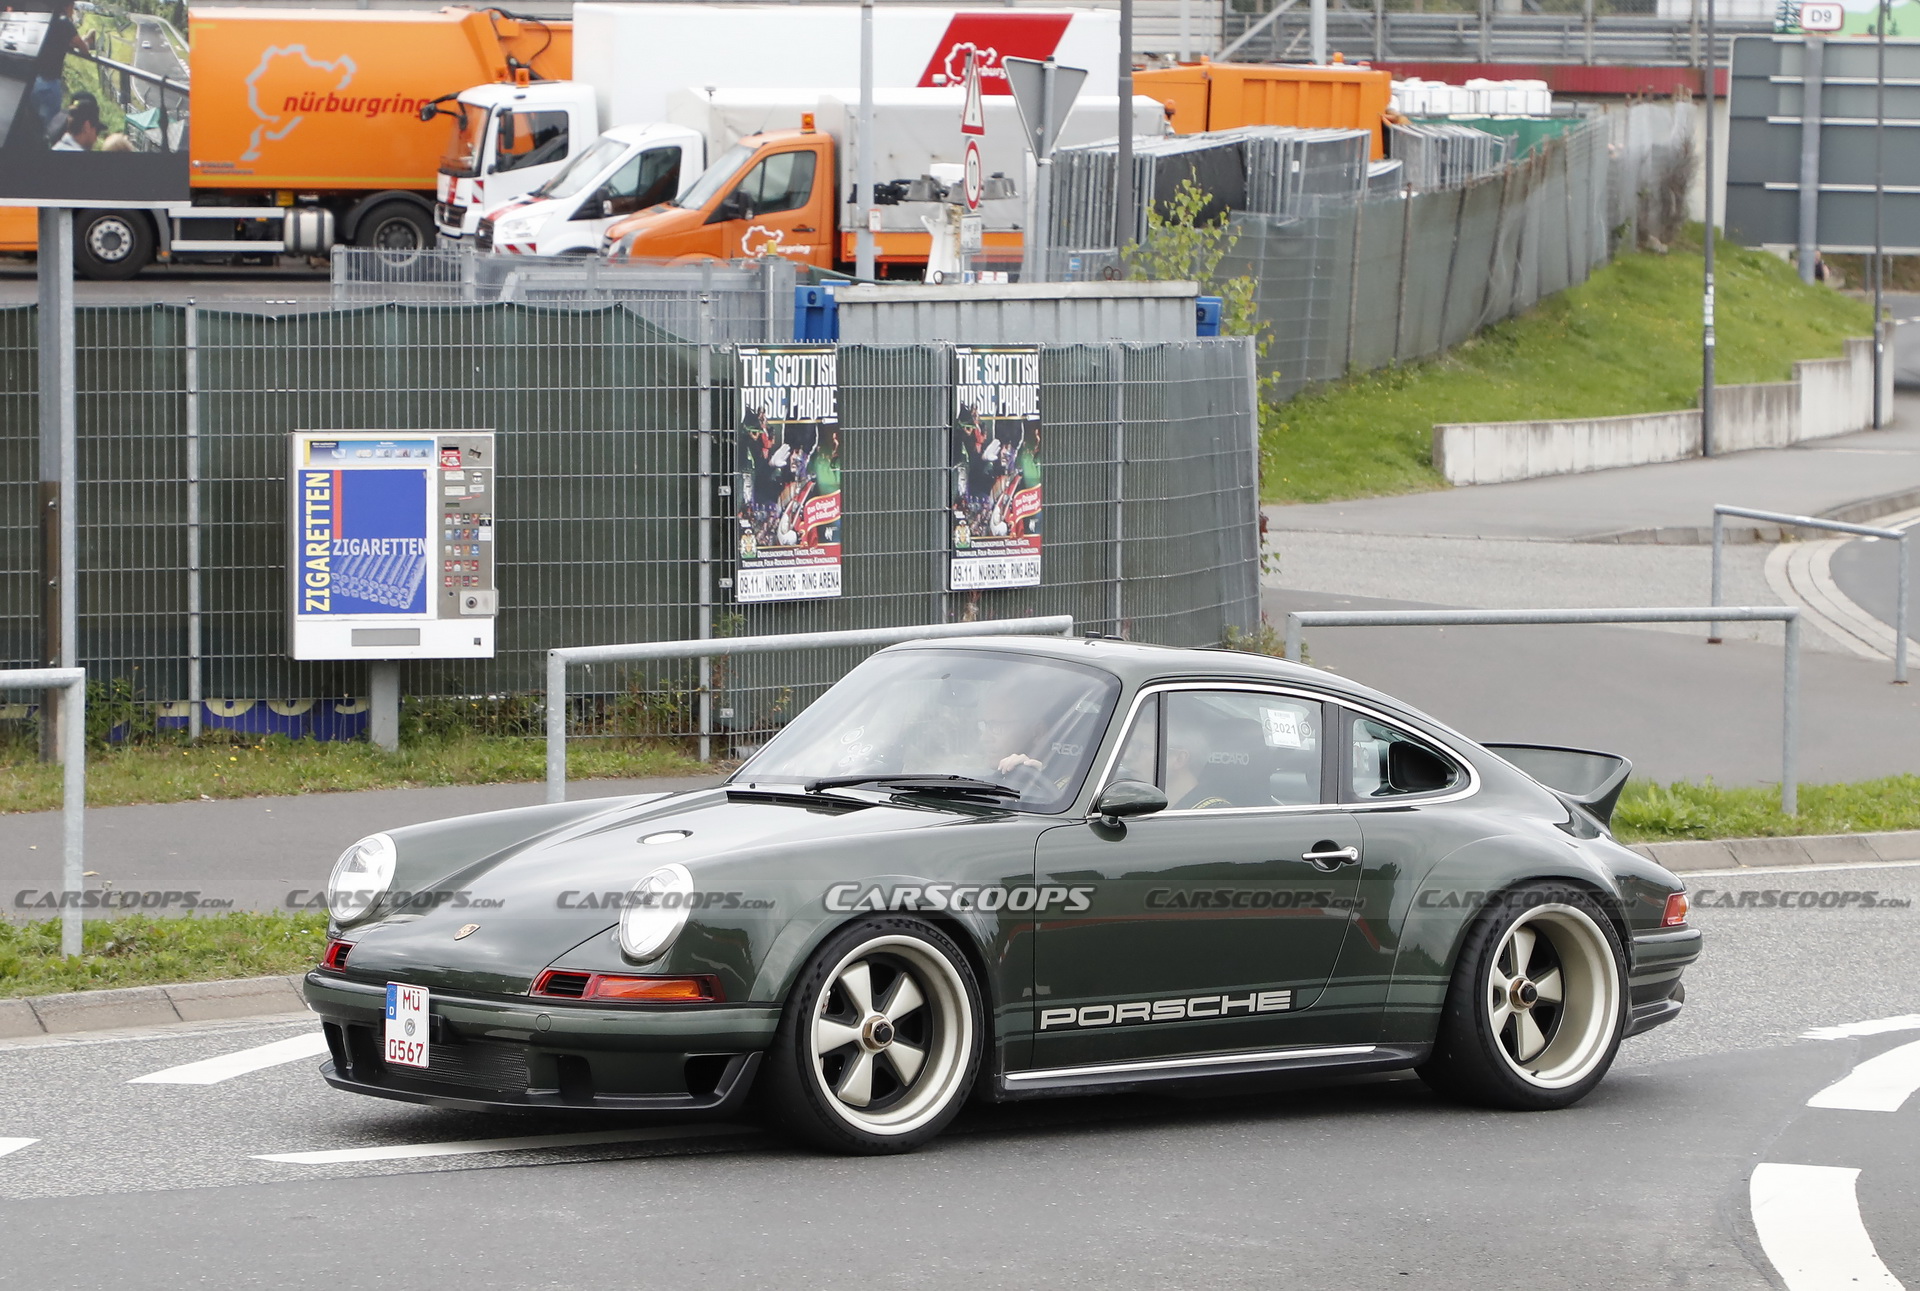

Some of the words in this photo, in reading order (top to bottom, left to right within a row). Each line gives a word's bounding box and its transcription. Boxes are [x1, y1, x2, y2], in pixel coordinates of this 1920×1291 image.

[1811, 9, 1832, 22] D9
[740, 355, 771, 387] THE
[774, 354, 837, 387] SCOTTISH
[956, 354, 981, 385] THE
[984, 354, 1039, 385] SCOTTISH
[741, 387, 787, 423] MUSIC
[790, 386, 838, 420] PARADE
[956, 385, 996, 419] MUSIC
[998, 384, 1040, 418] PARADE
[305, 472, 331, 612] ZIGARETTEN
[333, 538, 427, 556] ZIGARETTEN
[740, 576, 762, 594] 09.11.
[802, 572, 817, 590] RING
[819, 571, 840, 588] ARENA
[954, 565, 975, 582] 09.11.
[1011, 562, 1023, 579] RING
[1024, 562, 1039, 578] ARENA
[1273, 722, 1297, 735] 2021
[389, 1006, 394, 1016] D
[1040, 990, 1292, 1030] PORSCHE
[389, 1038, 424, 1064] 0567
